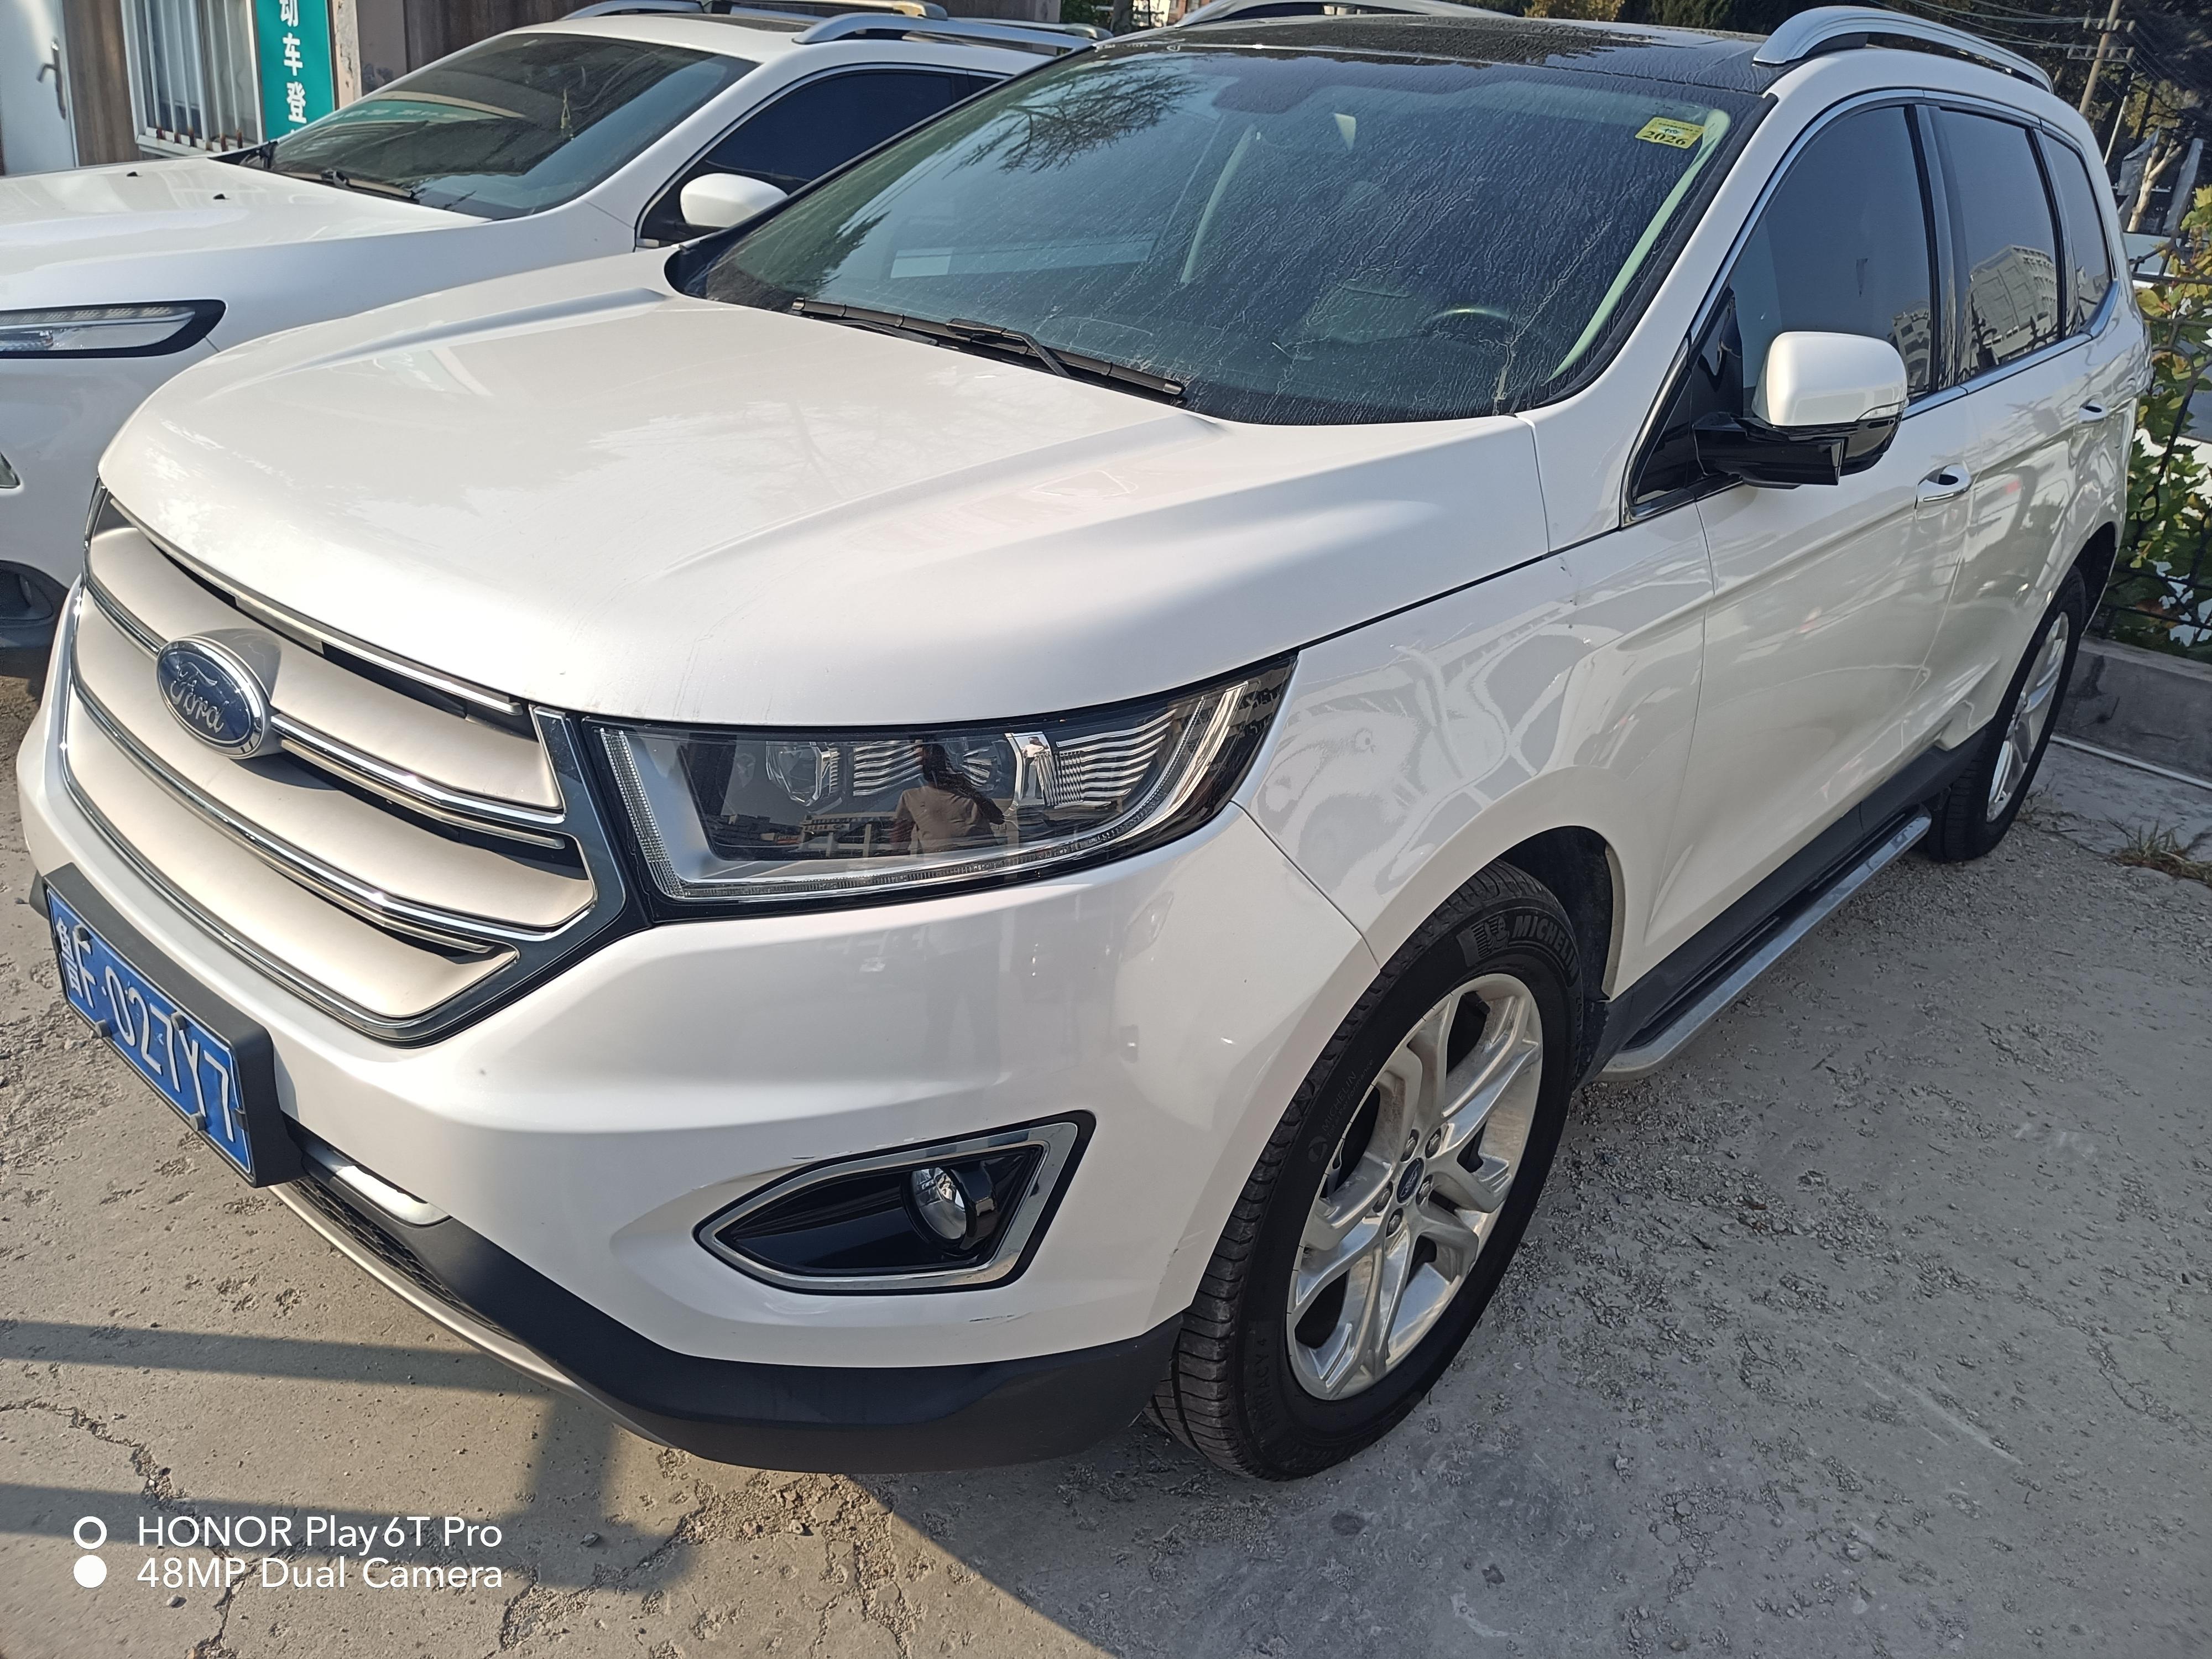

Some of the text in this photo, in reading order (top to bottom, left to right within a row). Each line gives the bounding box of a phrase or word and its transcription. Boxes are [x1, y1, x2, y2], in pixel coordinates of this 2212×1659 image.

[279, 0, 307, 134] 动车登
[1642, 131, 1688, 145] 2026
[170, 662, 229, 733] Ford
[1511, 915, 1579, 981] MICHELIN
[1321, 1071, 1357, 1132] MICHELIN
